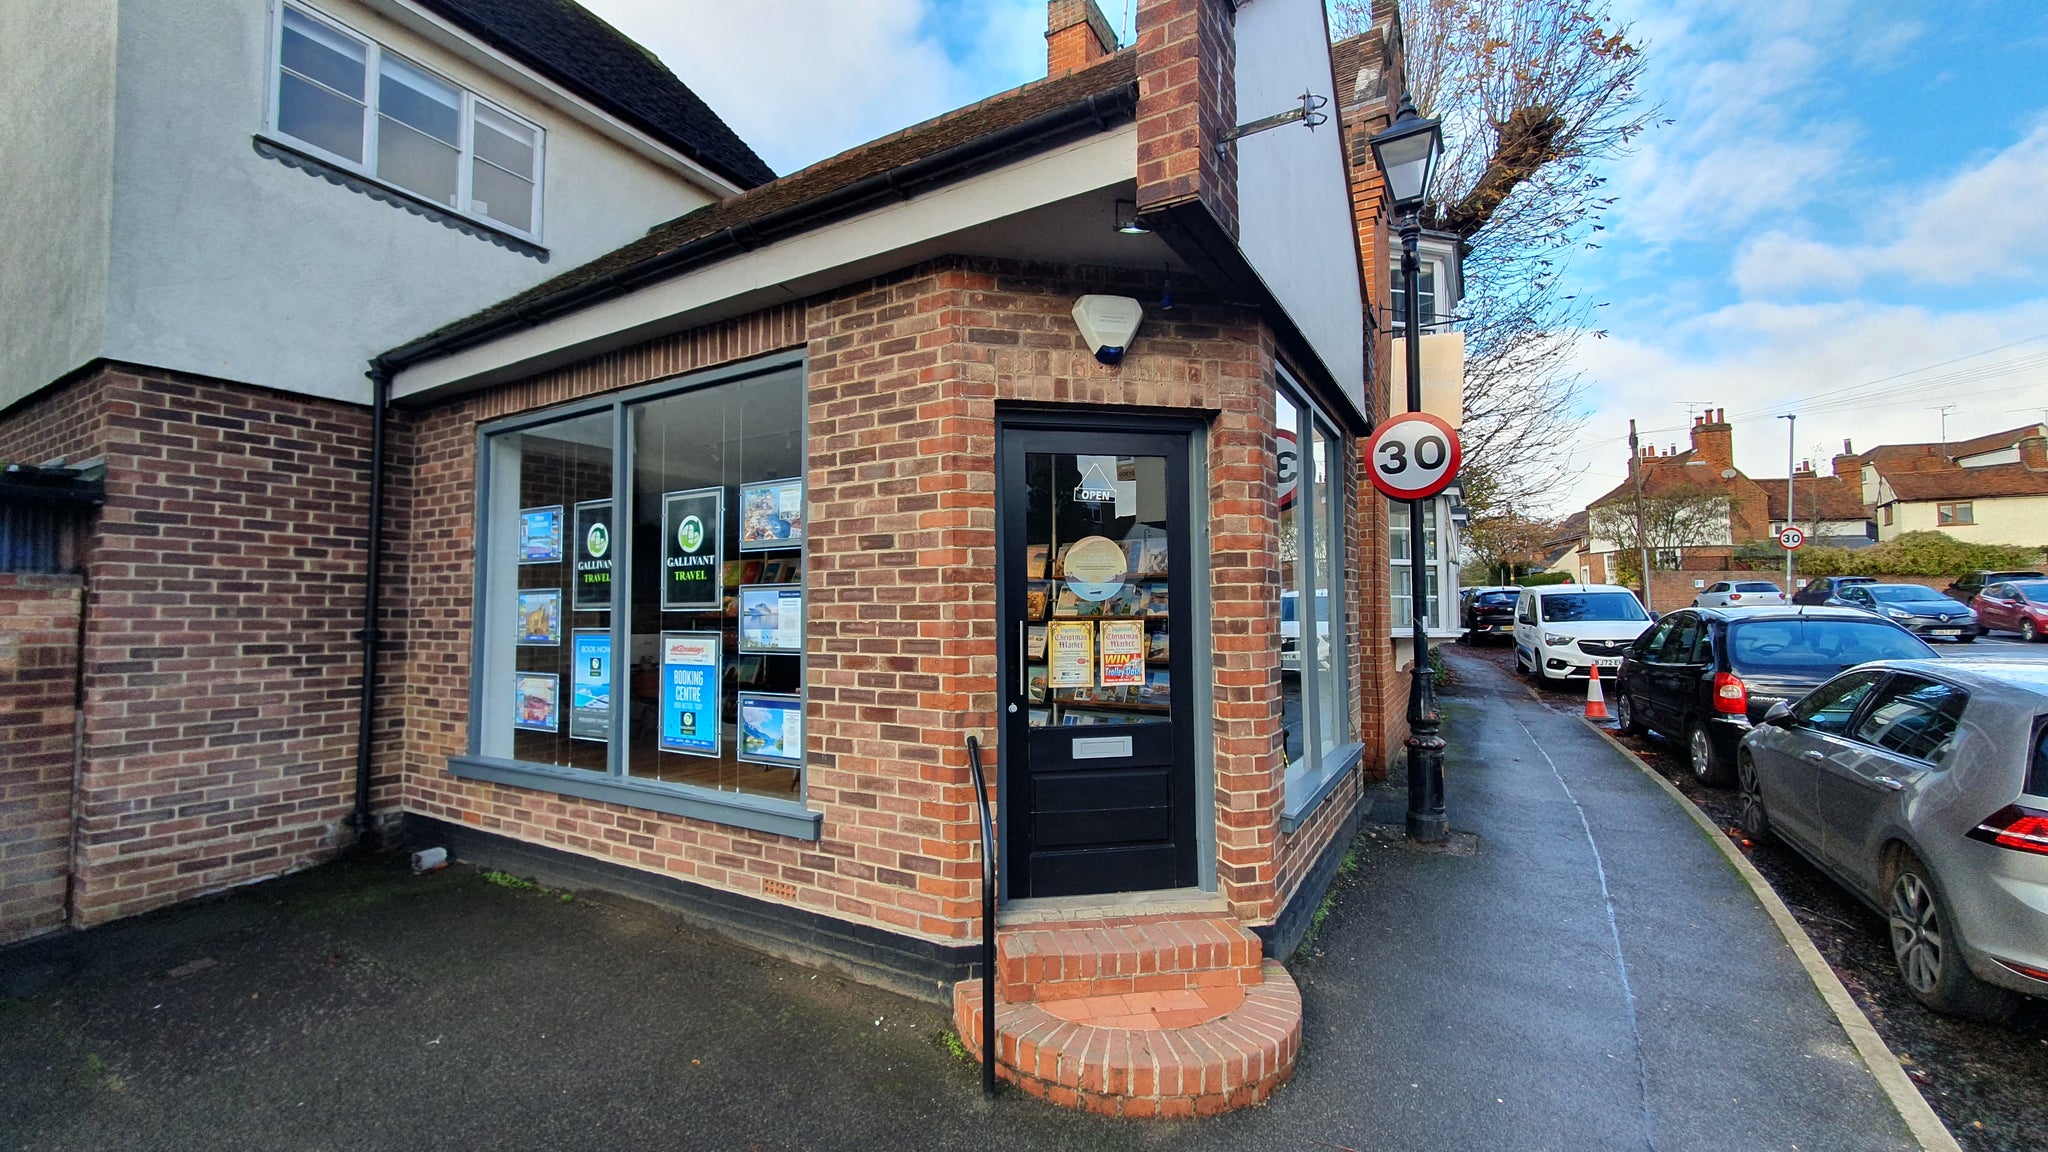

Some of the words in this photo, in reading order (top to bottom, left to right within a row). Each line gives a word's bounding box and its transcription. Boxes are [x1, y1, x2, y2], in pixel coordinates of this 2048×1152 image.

[1378, 435, 1447, 475] 30
[1081, 490, 1110, 501] OPEN
[1782, 533, 1801, 543] 30
[577, 559, 612, 571] GALLIVAN
[667, 555, 715, 567] GALLIVANT
[584, 573, 611, 583] TRAVEL
[674, 570, 707, 581] TRAVEL
[1054, 633, 1088, 641] Christmas
[1059, 641, 1083, 649] Market
[1110, 640, 1135, 648] Market
[1105, 654, 1130, 664] WIN
[1105, 666, 1124, 678] Trolley
[674, 670, 704, 686] BOOKING
[676, 686, 701, 702] CENTRE
